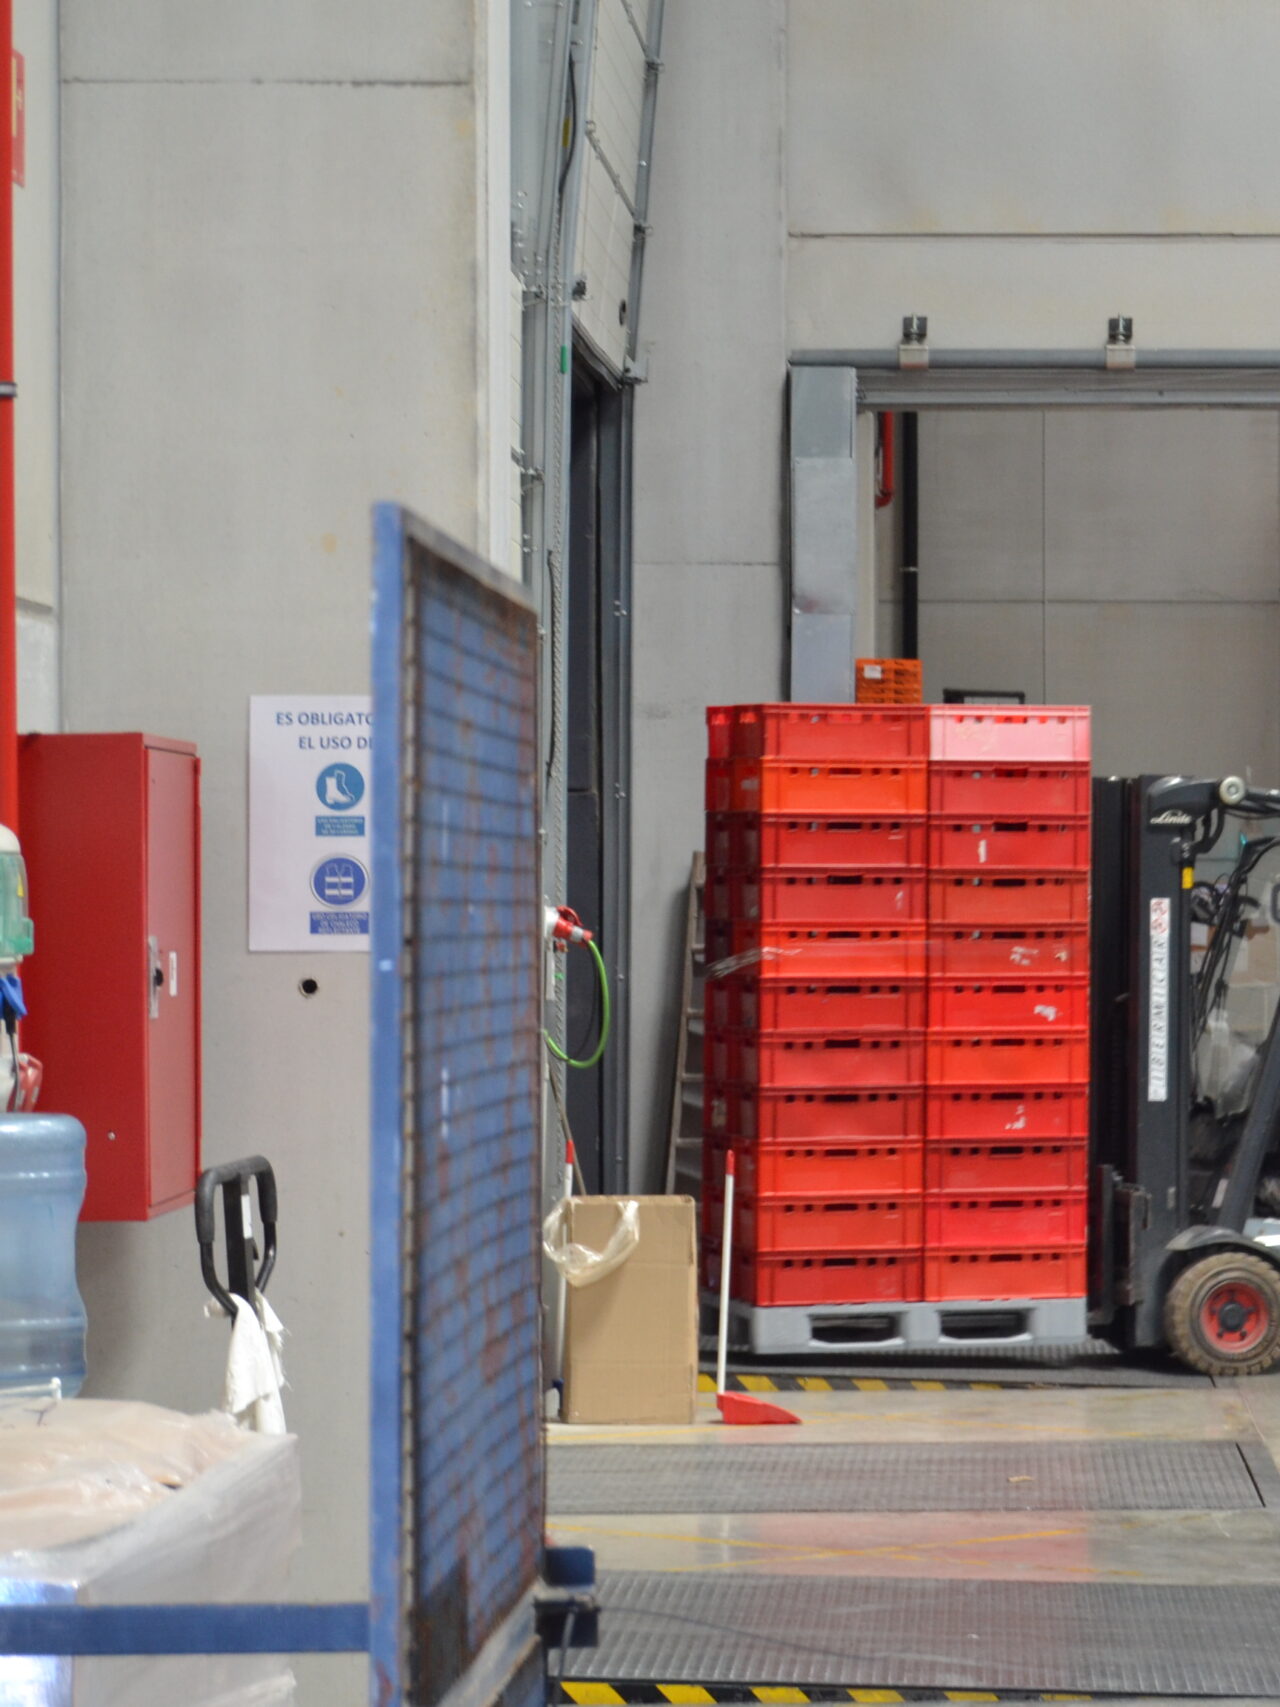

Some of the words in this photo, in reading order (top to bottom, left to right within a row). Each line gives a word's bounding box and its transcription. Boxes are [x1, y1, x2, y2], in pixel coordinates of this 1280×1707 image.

[276, 711, 294, 726] ES
[299, 736, 315, 750] EL
[320, 736, 352, 750] USO
